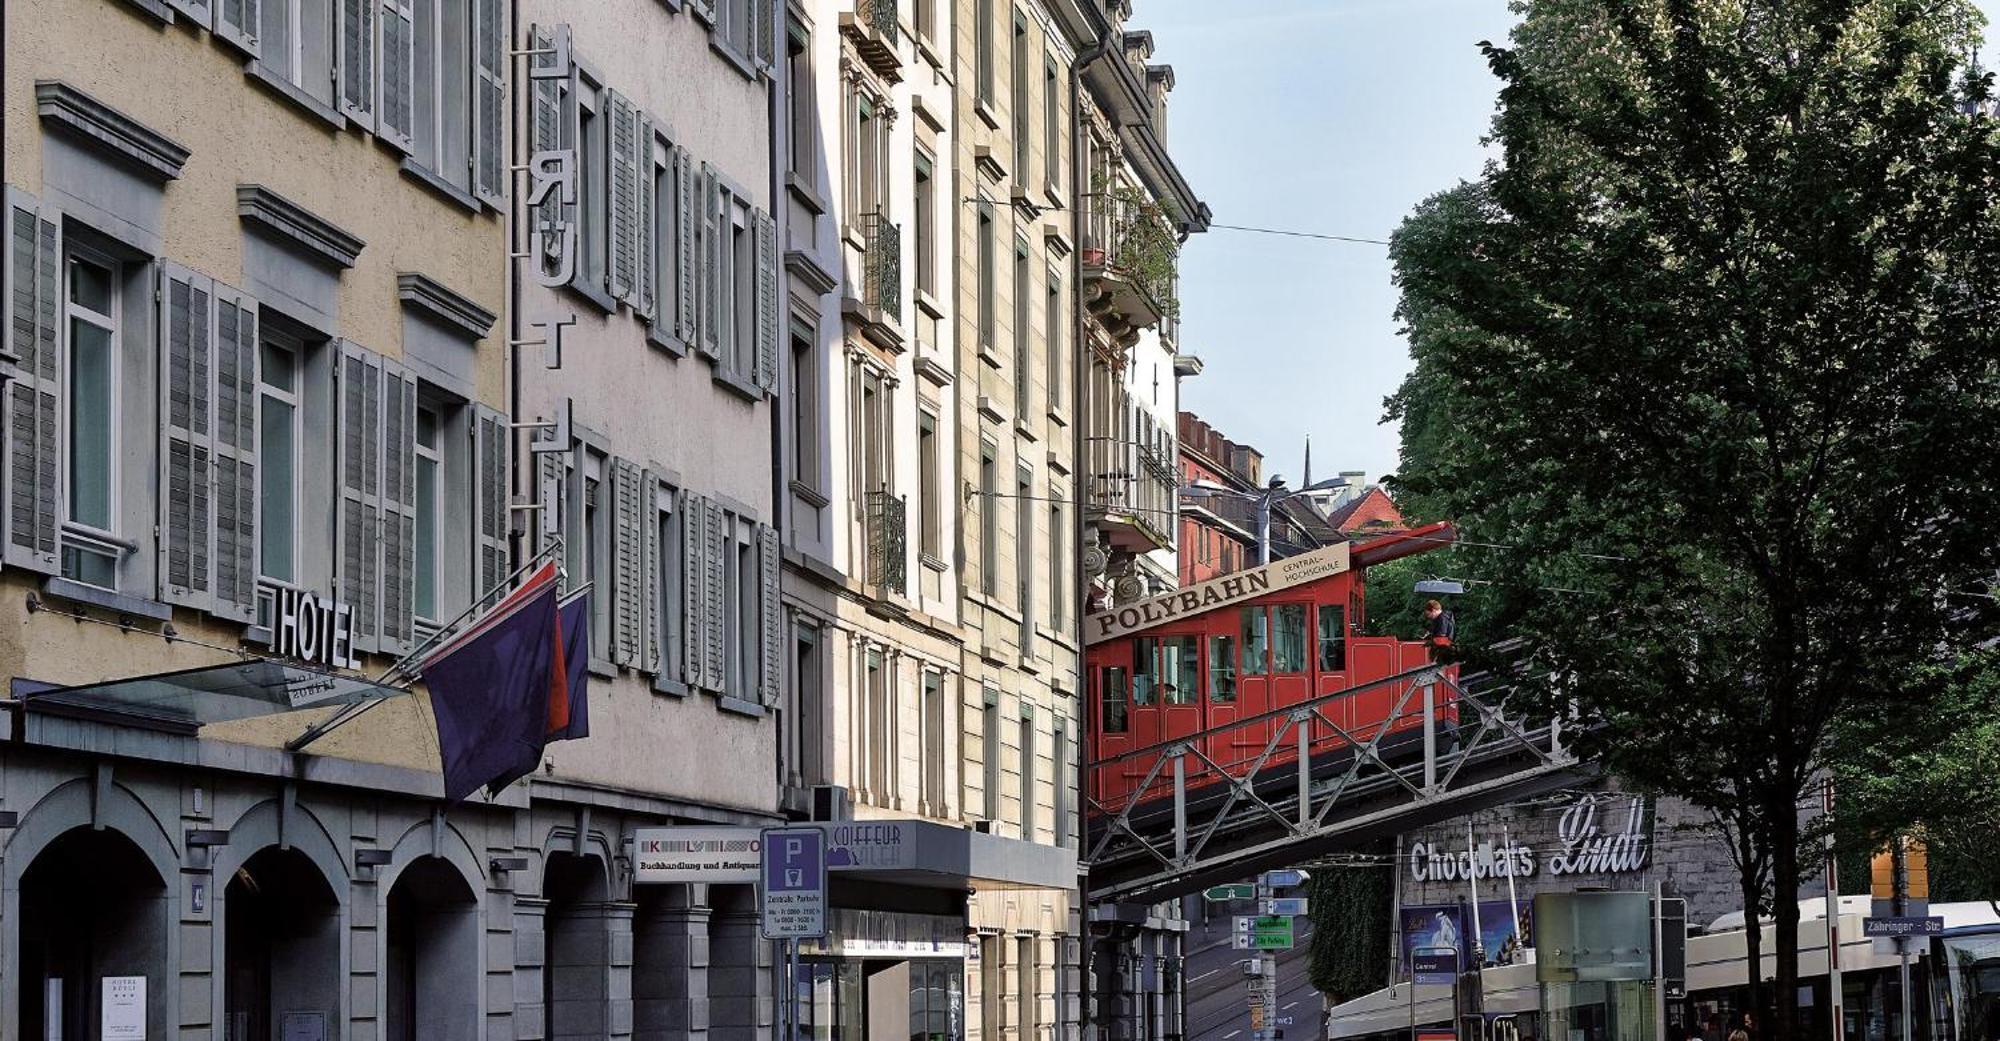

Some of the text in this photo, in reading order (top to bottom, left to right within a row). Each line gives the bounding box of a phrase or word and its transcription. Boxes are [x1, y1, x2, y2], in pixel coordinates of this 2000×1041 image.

[1285, 561, 1340, 582] HOCHSCHULE
[1097, 569, 1271, 636] POLYBAHN
[281, 588, 362, 670] HOTEL
[787, 838, 802, 864] P
[834, 825, 901, 846] COIFFEUR
[1551, 793, 1648, 875] Lindt
[640, 862, 701, 870] Buchhandlung
[703, 862, 719, 870] und
[1411, 839, 1534, 882] Chocolats
